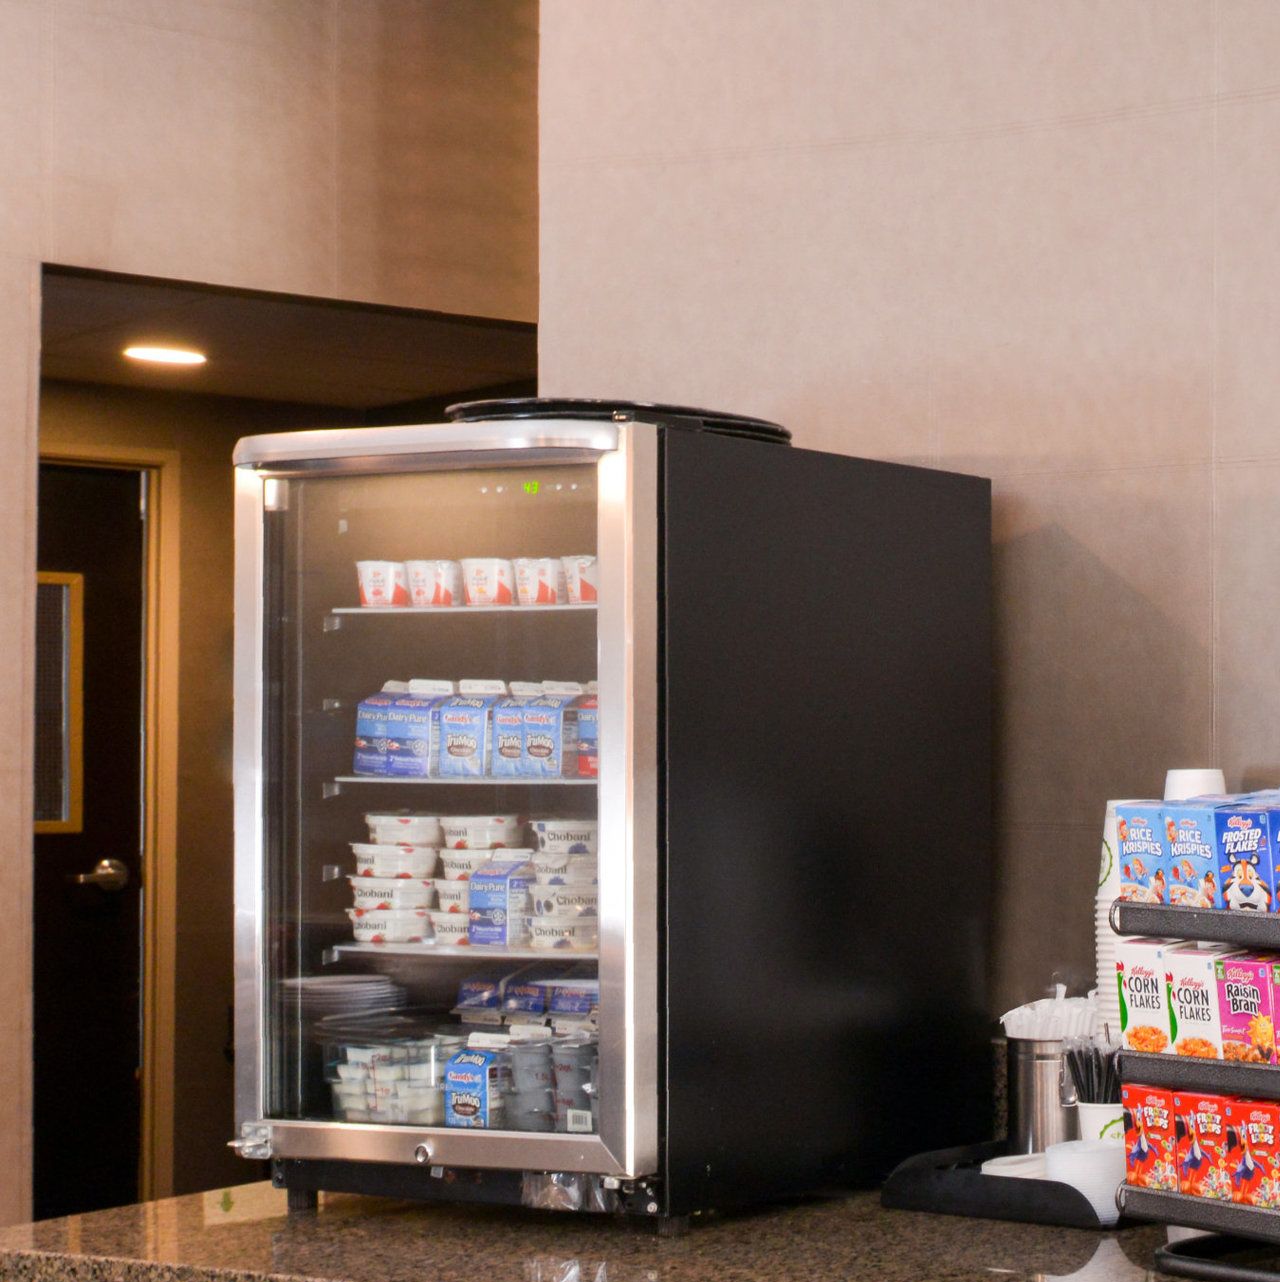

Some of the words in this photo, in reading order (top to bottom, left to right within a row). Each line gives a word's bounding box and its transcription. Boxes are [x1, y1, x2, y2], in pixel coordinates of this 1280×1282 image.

[548, 831, 591, 841] Chobani
[1130, 828, 1153, 842] RICE
[1179, 829, 1202, 844] RICE
[1222, 828, 1261, 843] FROSTED
[1122, 842, 1163, 857] KRISPIES
[1171, 842, 1212, 859] KRISPIES
[1226, 840, 1258, 854] FLAKES
[470, 882, 505, 894] DairyPure
[556, 895, 597, 905] Choban
[438, 924, 469, 934] Choban
[1128, 976, 1159, 994] CORN
[1177, 988, 1209, 1006] CORN
[1226, 984, 1260, 1001] Raisin
[1130, 994, 1161, 1009] FLAKES
[1231, 999, 1257, 1015] Bran
[1180, 1006, 1212, 1021] FLAKES
[452, 1092, 480, 1107] TruMoo
[1143, 1106, 1168, 1119] FROOT
[1196, 1112, 1221, 1124] FROOT
[1146, 1117, 1168, 1129] LOOPS
[1199, 1123, 1221, 1134] LOOPS
[1248, 1123, 1274, 1134] FROOT
[1251, 1133, 1274, 1145] LOOPS
